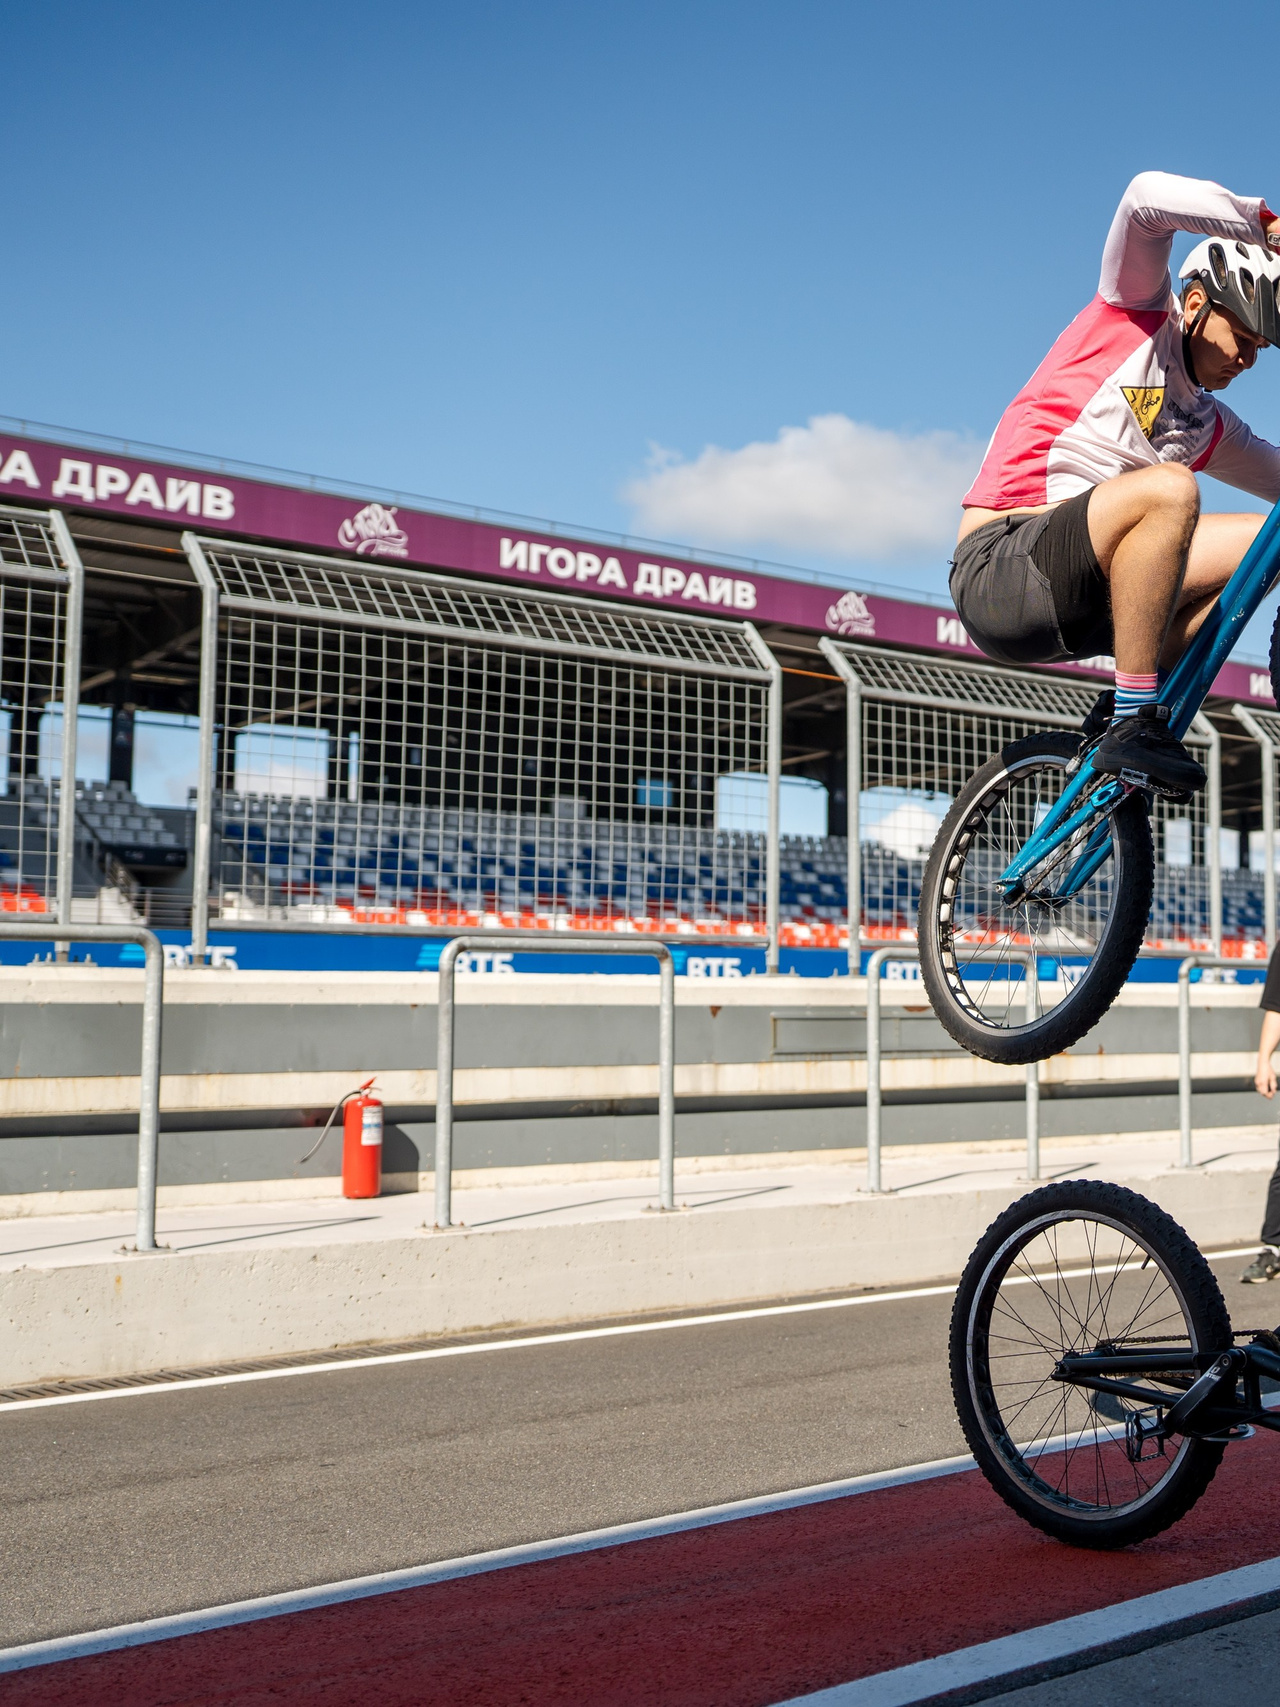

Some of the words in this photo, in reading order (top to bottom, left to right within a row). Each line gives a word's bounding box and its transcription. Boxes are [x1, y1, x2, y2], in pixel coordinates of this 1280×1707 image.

[0, 449, 41, 489] А
[52, 458, 235, 521] ДРАЙВ
[500, 537, 628, 589] ИГОРА
[633, 562, 757, 611] ДРАЙВ
[687, 957, 744, 977] ВТБ
[886, 962, 923, 979] ВТ
